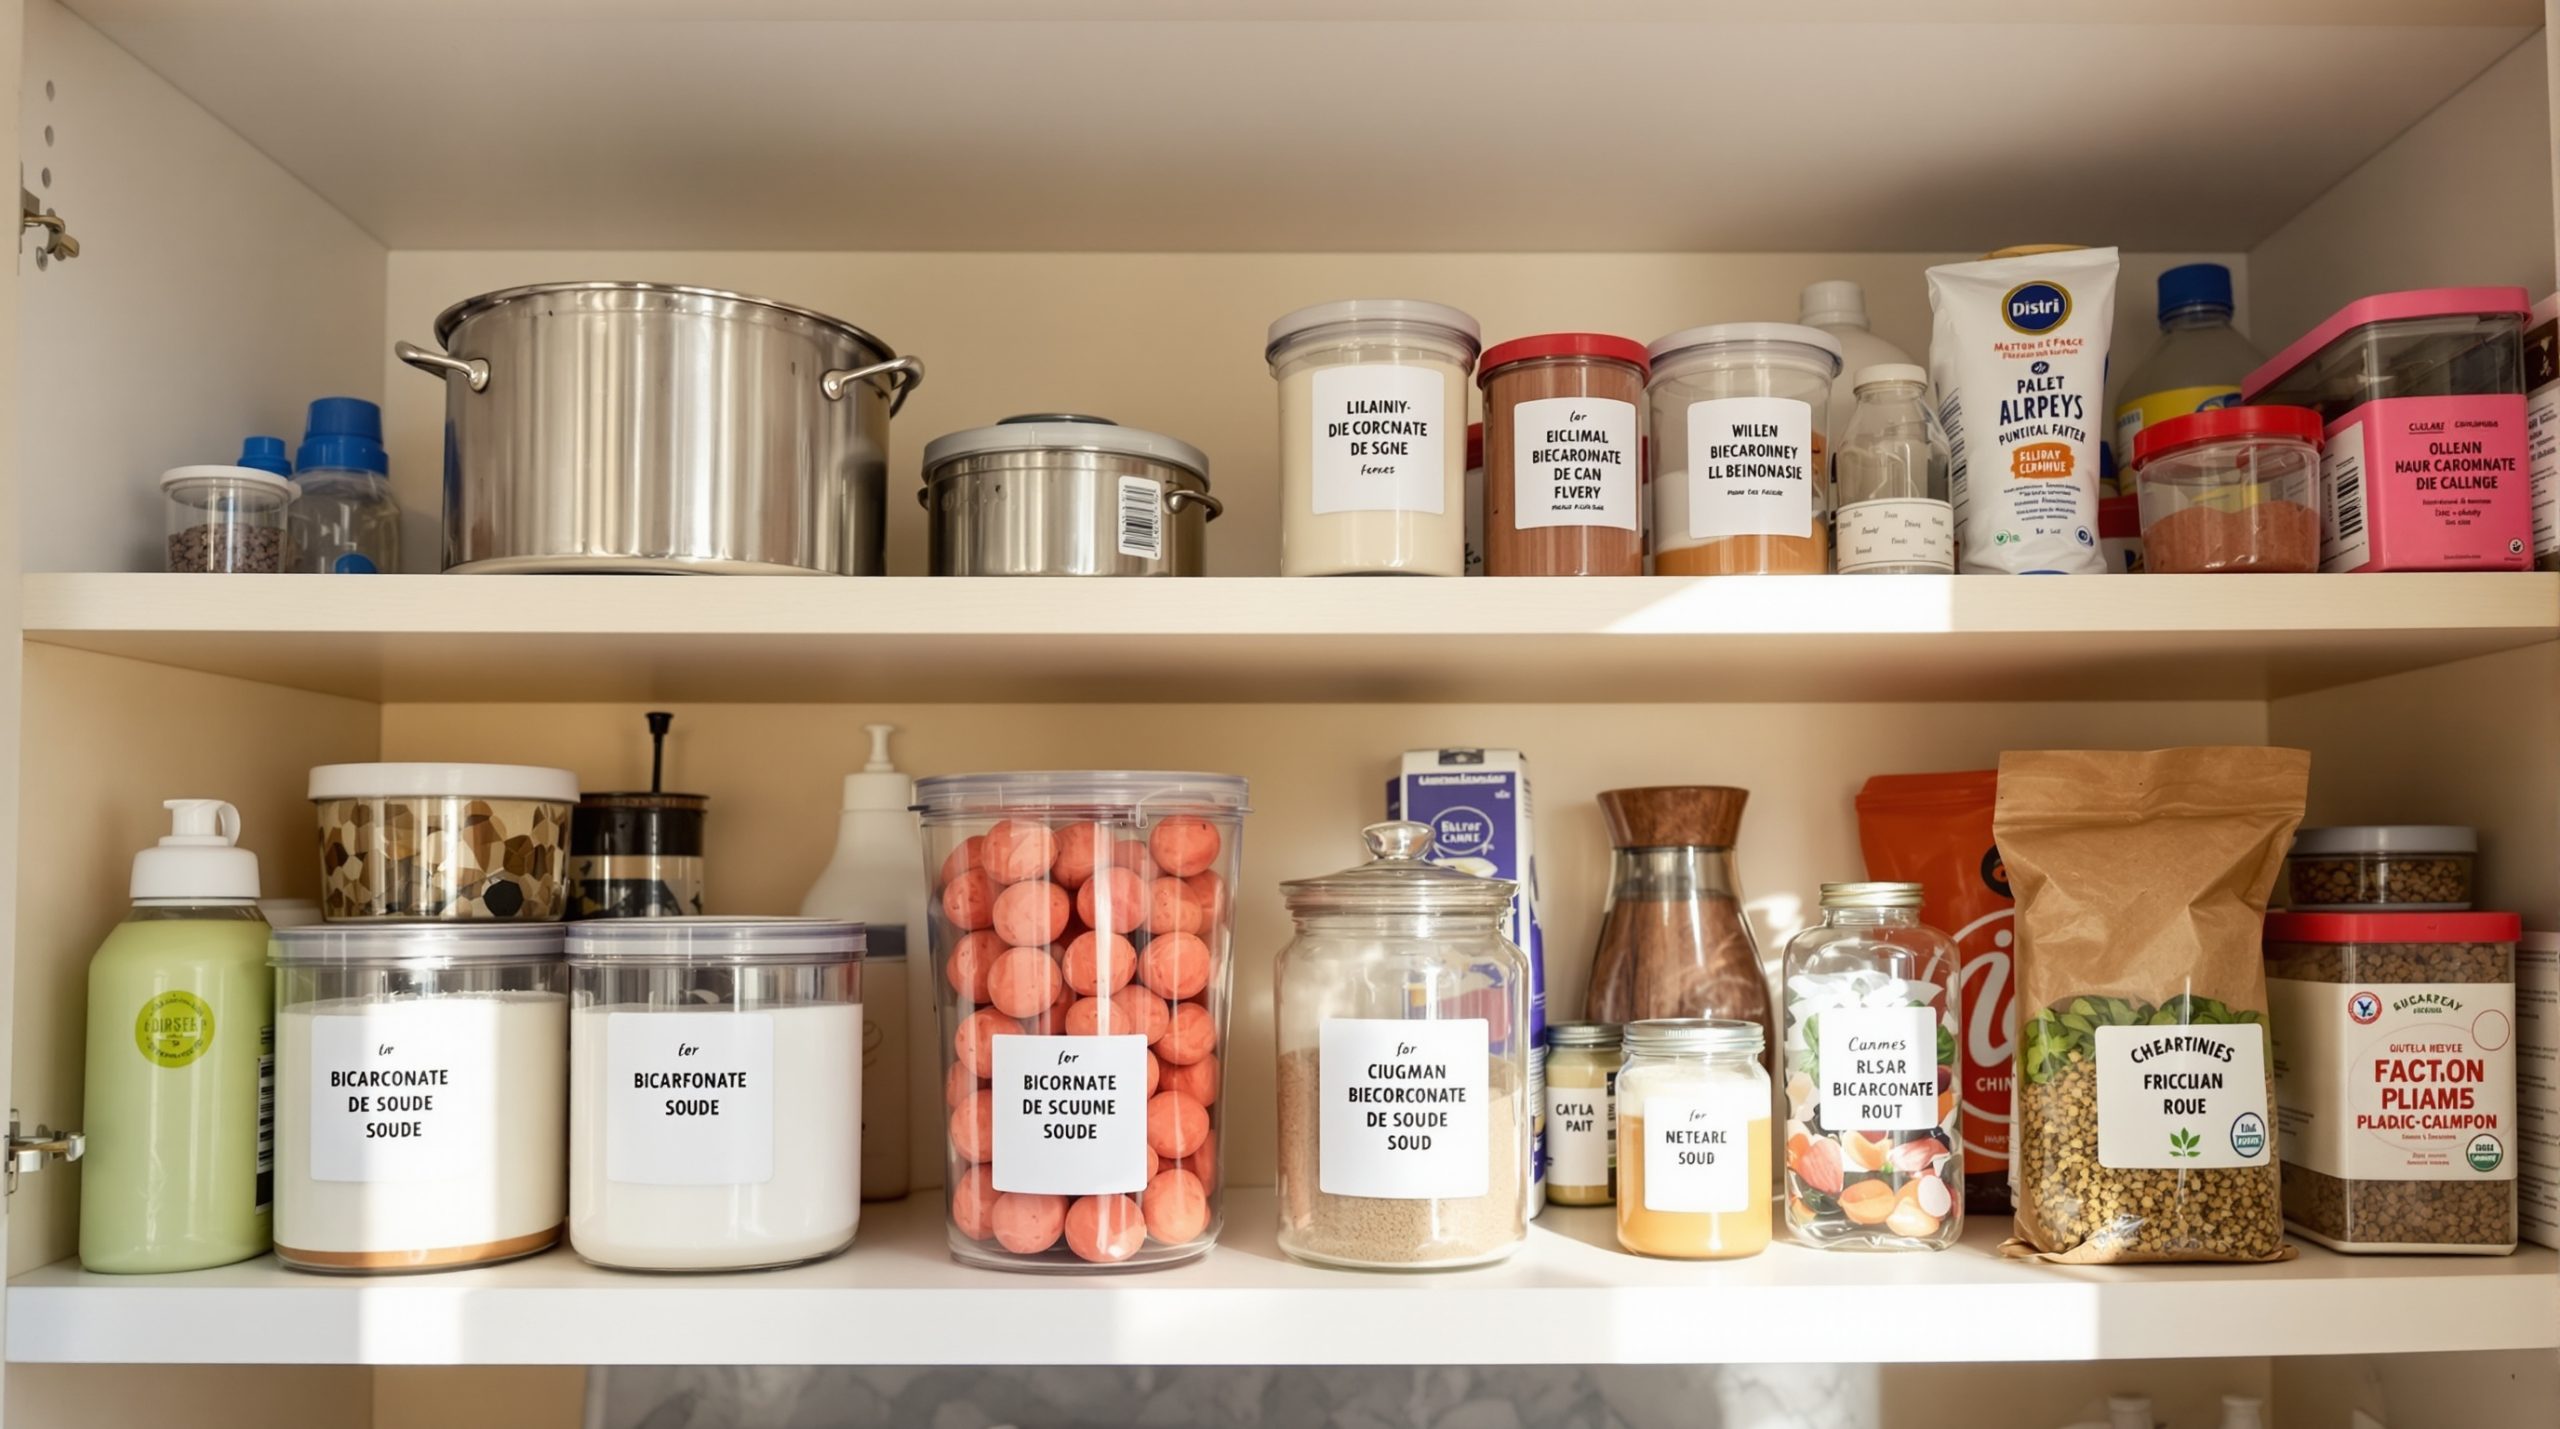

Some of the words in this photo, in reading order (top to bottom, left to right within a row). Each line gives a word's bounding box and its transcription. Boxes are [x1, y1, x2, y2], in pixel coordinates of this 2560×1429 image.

[2012, 299, 2059, 317] Distri
[2017, 376, 2064, 394] PALET
[2000, 394, 2083, 426] ALRPEYS
[1328, 422, 1350, 437] DIE
[1352, 420, 1428, 437] CORCNATE
[1732, 424, 1778, 438] WILLEN
[1351, 441, 1368, 456] DE
[1371, 441, 1408, 455] SGNE
[2429, 441, 2482, 455] OLLENN
[1709, 466, 1723, 479] LL
[2395, 459, 2430, 473] HAUR
[1554, 468, 1571, 481] DE
[1574, 467, 1601, 481] CAN
[2416, 477, 2437, 490] DIE
[2440, 476, 2498, 489] CALLNGE
[1554, 486, 1601, 499] FLVERY
[1396, 1042, 1417, 1057] for
[2131, 1036, 2235, 1063] CHEARTINIES
[1368, 1064, 1446, 1079] CIUGMAN
[1857, 1060, 1906, 1074] RLSAR
[331, 1069, 449, 1087] BICARCONATE
[634, 1072, 747, 1088] BICARFONATE
[1024, 1074, 1116, 1091] BICORNATE
[1348, 1087, 1466, 1103] BIECORCONATE
[1833, 1081, 1933, 1096] BICARCONATE
[348, 1096, 370, 1113] DE
[376, 1095, 433, 1112] SOUDE
[665, 1099, 719, 1116] SOUDE
[1023, 1099, 1042, 1115] DE
[1862, 1104, 1902, 1119] ROUT
[2163, 1098, 2206, 1115] ROUE
[1367, 1112, 1387, 1128] DE
[1393, 1112, 1448, 1128] SOUDE
[1566, 1120, 1594, 1132] PAIT
[366, 1121, 422, 1138] SOUDE
[1044, 1124, 1097, 1139] SOUDE
[1388, 1135, 1432, 1150] SOUD
[1678, 1152, 1715, 1165] SOUD
